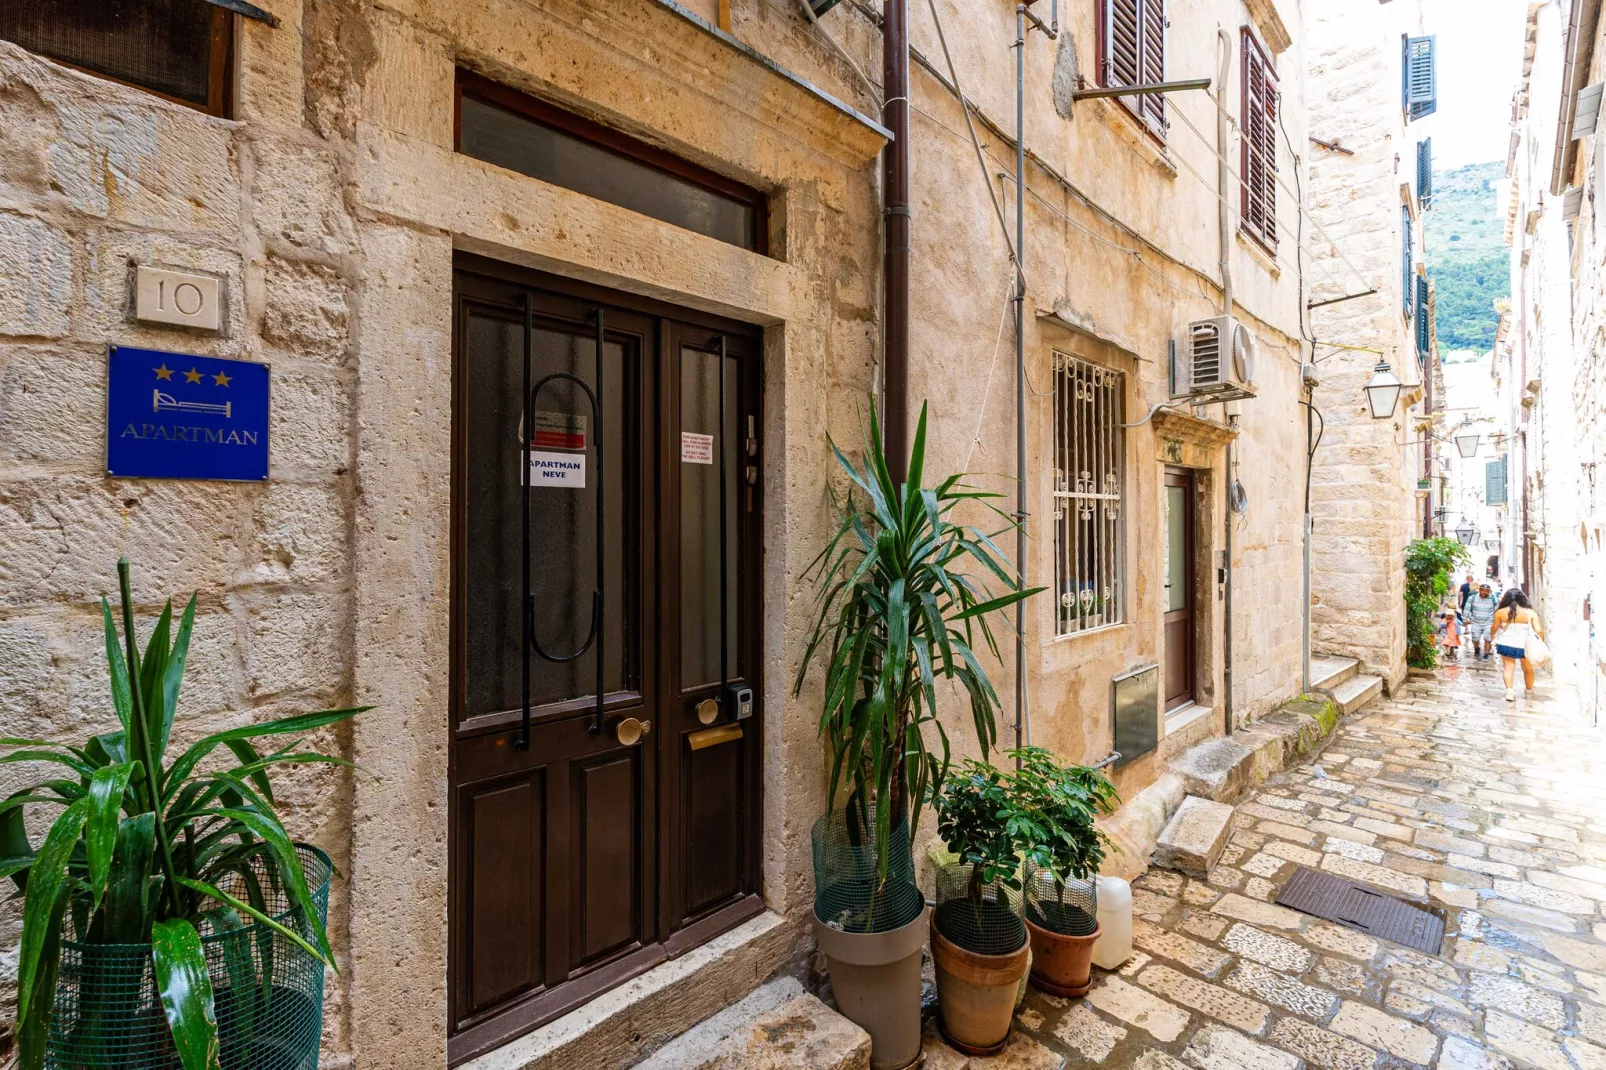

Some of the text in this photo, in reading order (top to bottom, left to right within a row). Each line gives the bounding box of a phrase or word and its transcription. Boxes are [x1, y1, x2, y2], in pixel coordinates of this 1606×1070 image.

[157, 280, 204, 316] 10
[120, 422, 258, 446] APARTMAN
[542, 471, 566, 479] NEVE
